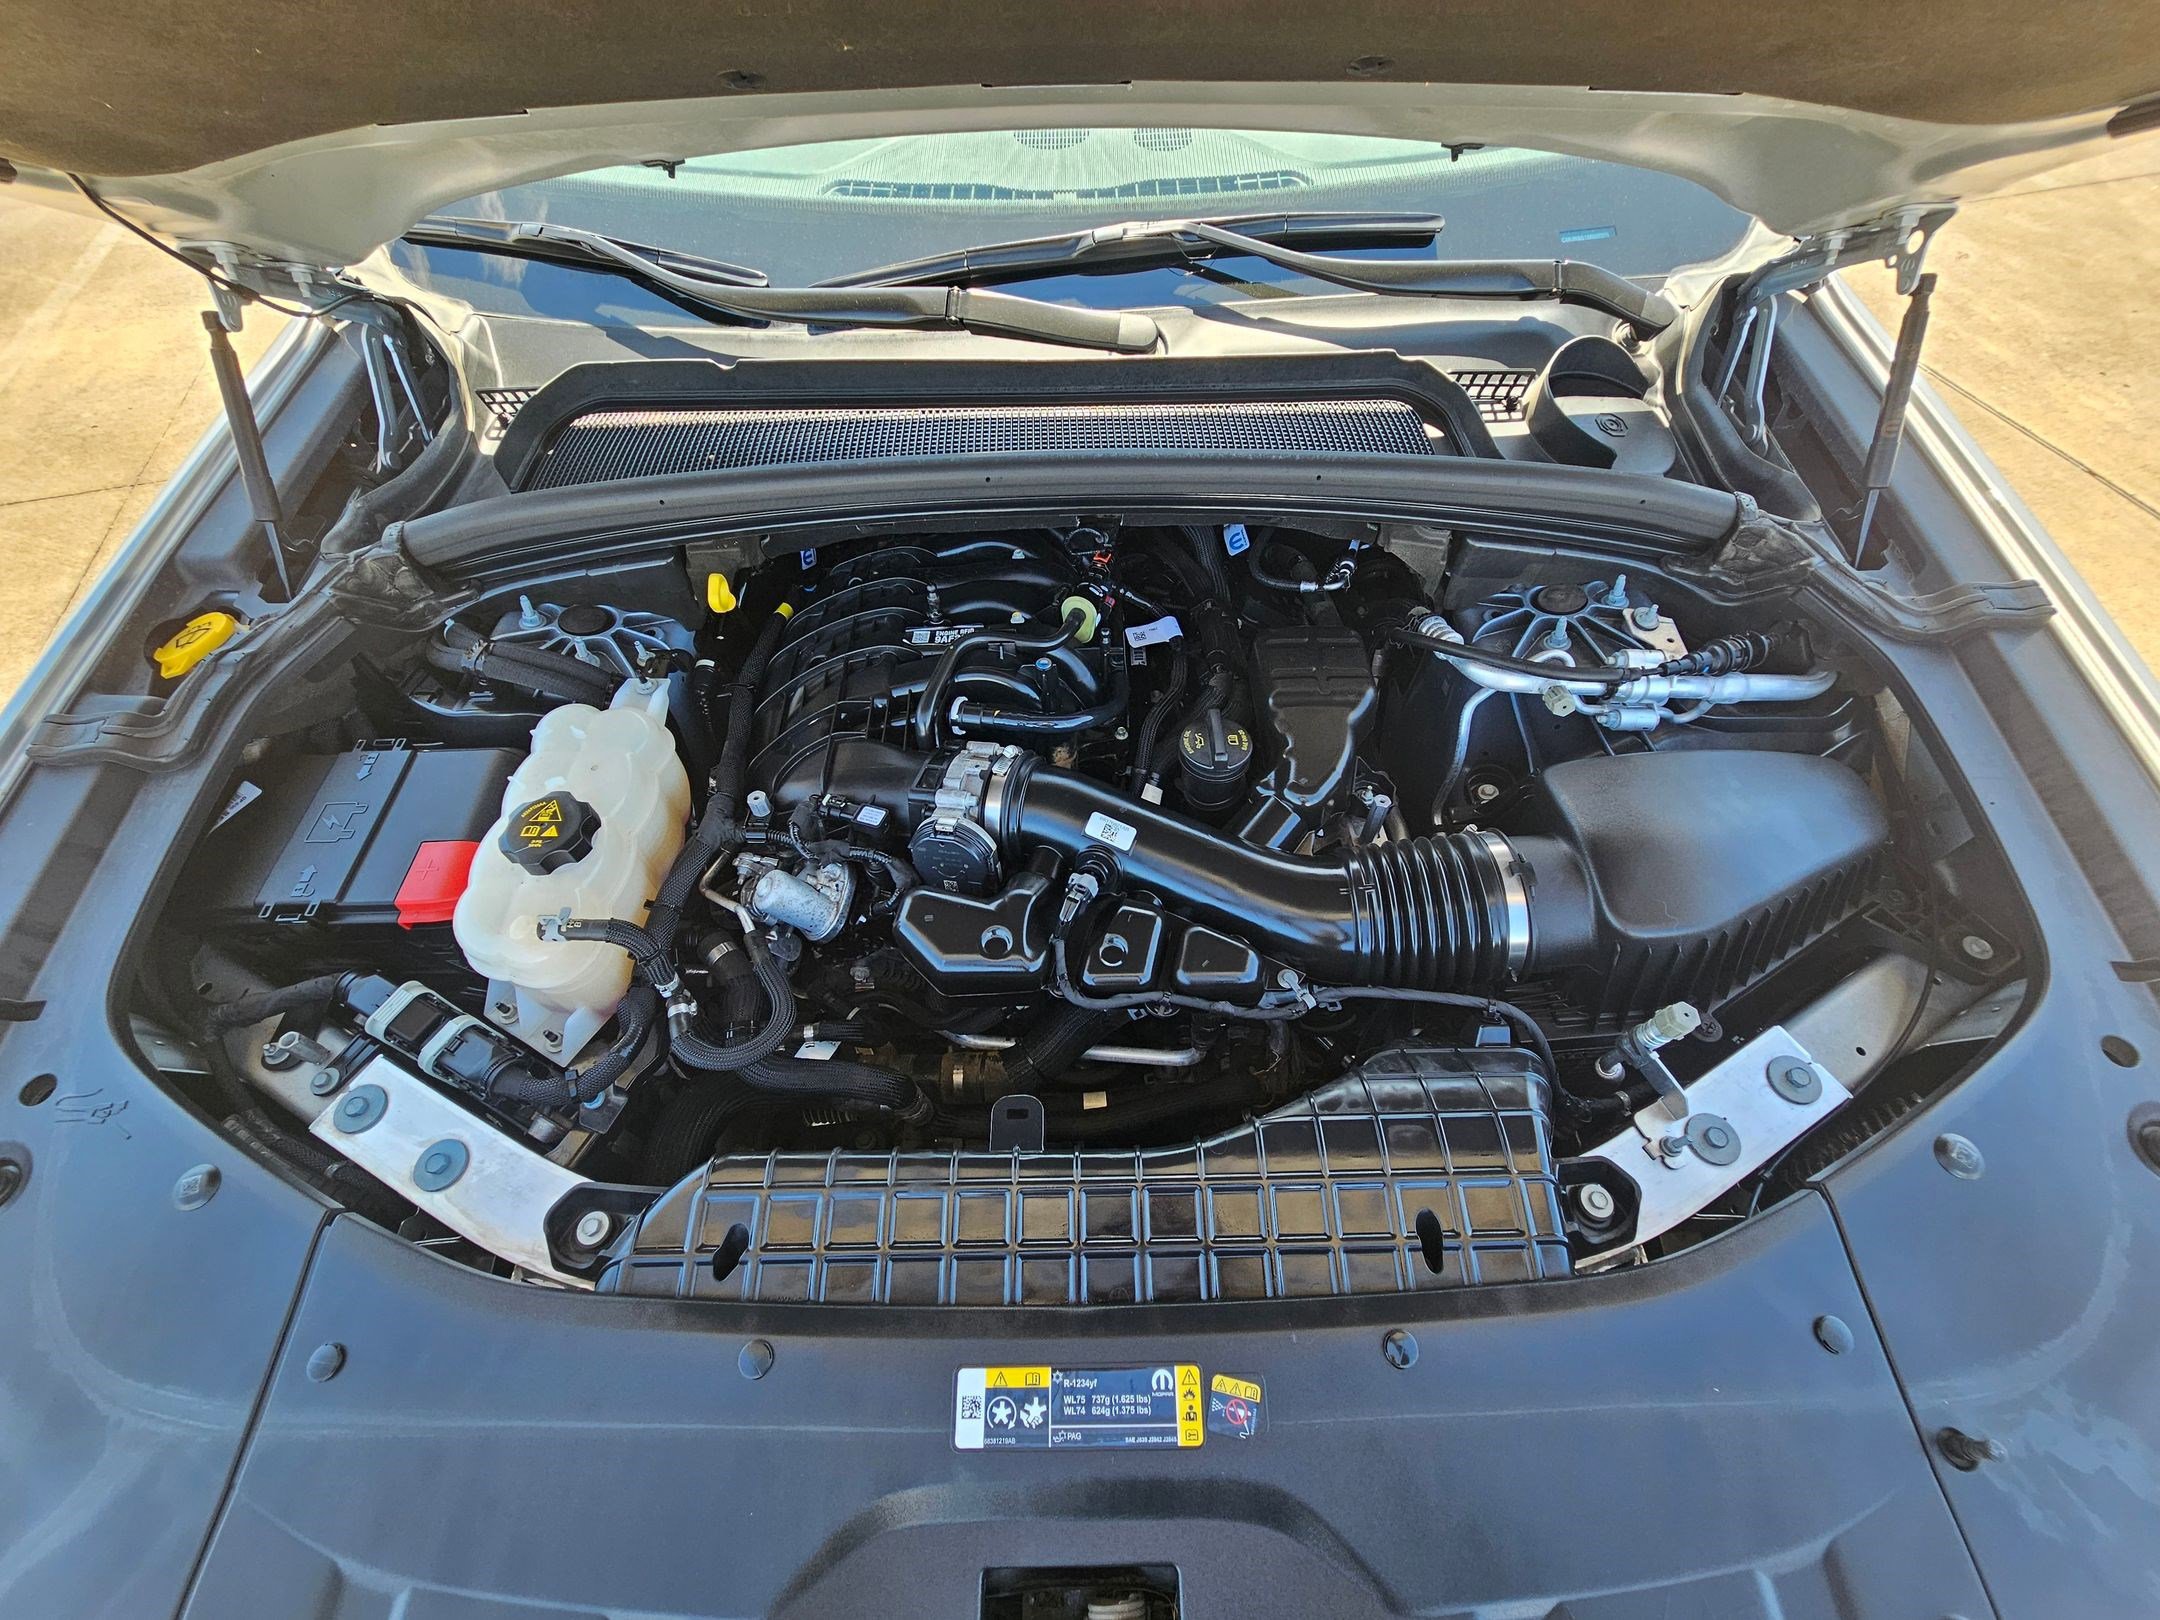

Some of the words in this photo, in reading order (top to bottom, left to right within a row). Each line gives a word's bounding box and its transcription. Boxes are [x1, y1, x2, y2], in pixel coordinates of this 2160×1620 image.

[1063, 1378, 1098, 1390] R-1234yf
[1063, 1395, 1086, 1405] WL75
[1091, 1395, 1111, 1406] 737g
[1111, 1394, 1135, 1405] (1.625
[1136, 1394, 1151, 1405] lbs)
[1063, 1406, 1086, 1415] WL74
[1091, 1406, 1111, 1417] 624g
[1111, 1405, 1136, 1417] (1.375
[1136, 1405, 1152, 1417] lbs)
[1067, 1432, 1081, 1440] PAG
